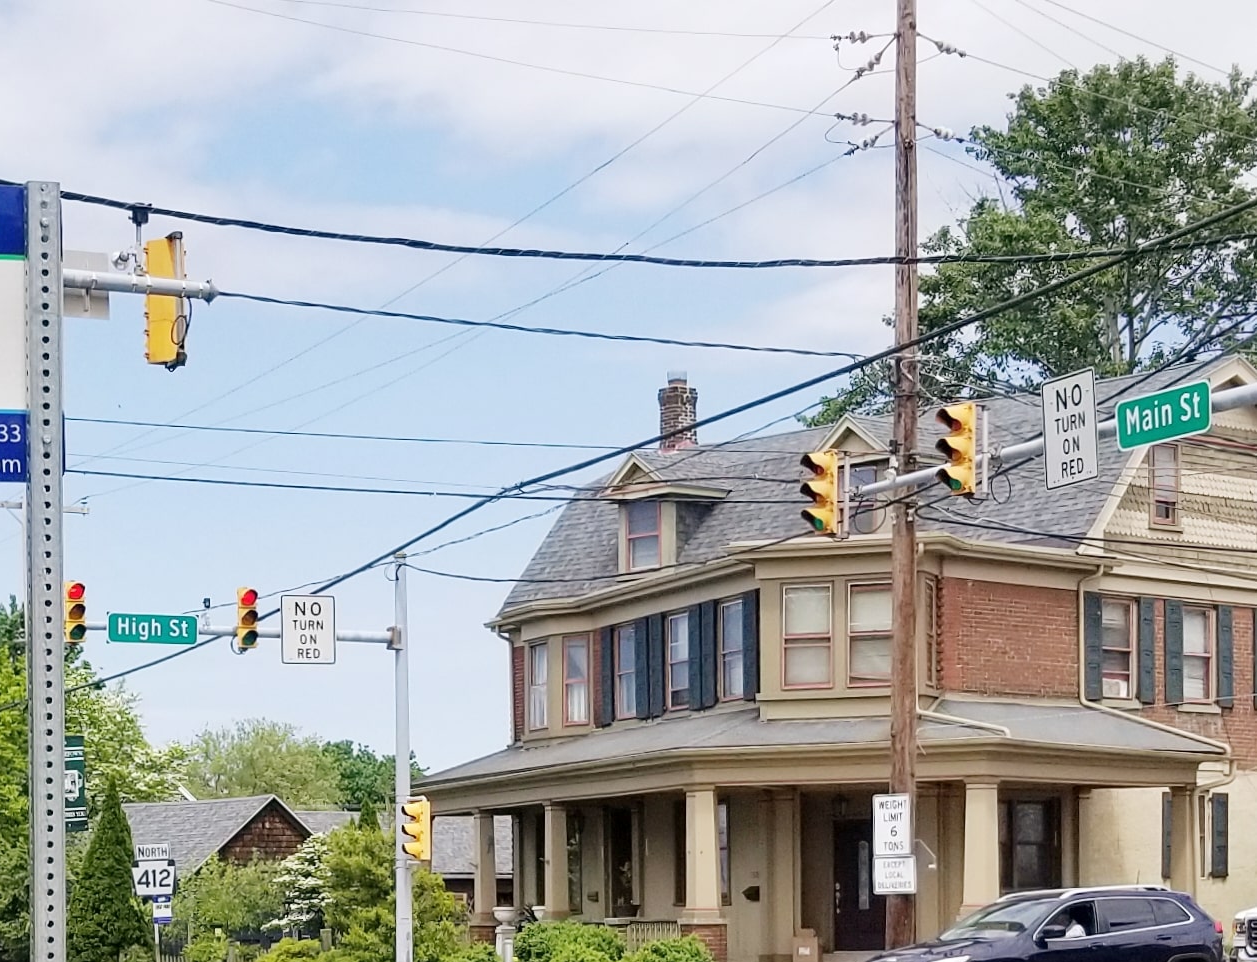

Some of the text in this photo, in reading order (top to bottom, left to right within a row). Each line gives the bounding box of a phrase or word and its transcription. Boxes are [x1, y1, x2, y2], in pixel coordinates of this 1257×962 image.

[1055, 383, 1082, 412] NO
[1125, 391, 1201, 436] Main St
[1054, 411, 1086, 435] TURN
[1062, 436, 1080, 455] ON
[1061, 458, 1084, 479] RED
[294, 601, 322, 617] NO
[116, 617, 189, 641] High St
[292, 619, 325, 632] TURN
[299, 634, 318, 646] ON
[296, 648, 321, 660] RED
[878, 799, 907, 810] WEIGHT
[883, 812, 903, 822] LIMIT
[890, 826, 898, 837] 6
[137, 846, 168, 858] NORTH
[883, 841, 904, 852] TONS
[136, 868, 172, 889] 412
